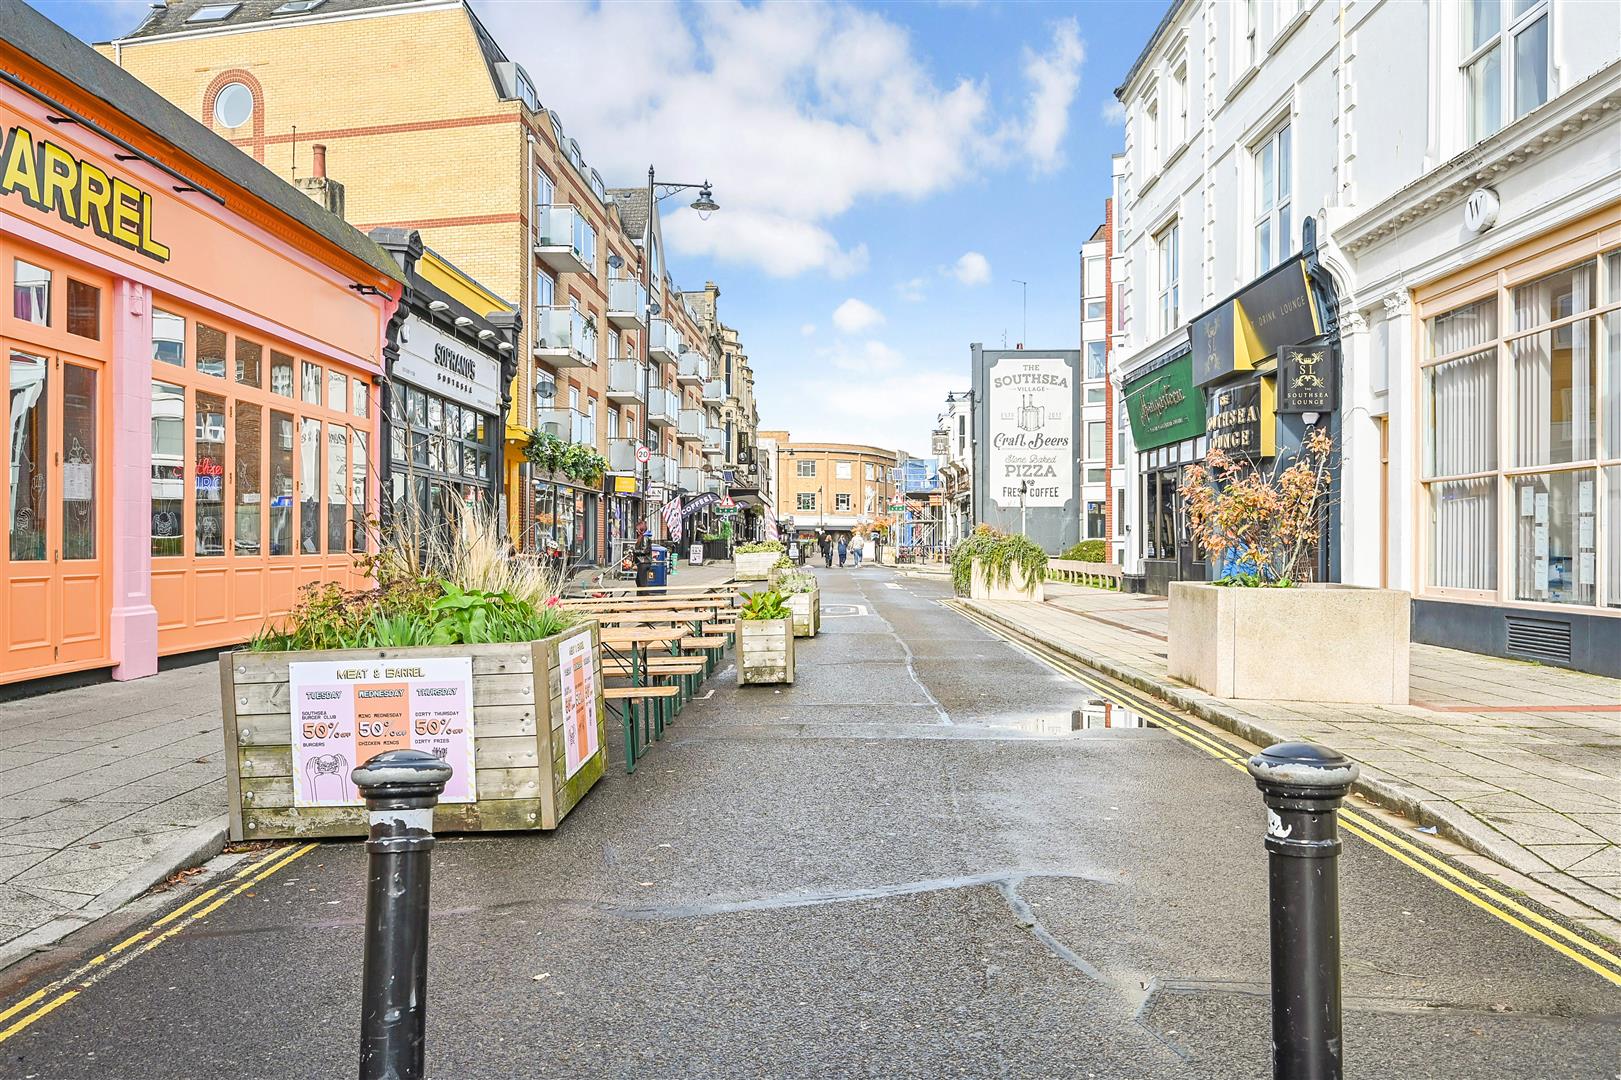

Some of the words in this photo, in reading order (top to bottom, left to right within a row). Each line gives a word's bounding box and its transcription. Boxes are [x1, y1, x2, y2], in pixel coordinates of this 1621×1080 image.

[0, 125, 170, 263] ARREL
[1280, 296, 1305, 316] LOUNGE
[994, 373, 1068, 388] SOUTHSEA
[993, 432, 1026, 451] Craft
[1028, 432, 1069, 450] Beers
[638, 450, 648, 458] 20
[1005, 464, 1057, 478] PIZZA
[1029, 486, 1059, 498] COFFEE
[681, 494, 713, 515] COFFEE!
[336, 670, 368, 680] MEAT
[373, 671, 380, 679] &
[385, 667, 425, 679] BARREL
[306, 690, 342, 700] TUESDAY
[358, 688, 404, 699] WEDNESDAY
[416, 687, 458, 697] THURSDAY
[303, 721, 340, 739] 50%
[415, 718, 452, 735] 50%
